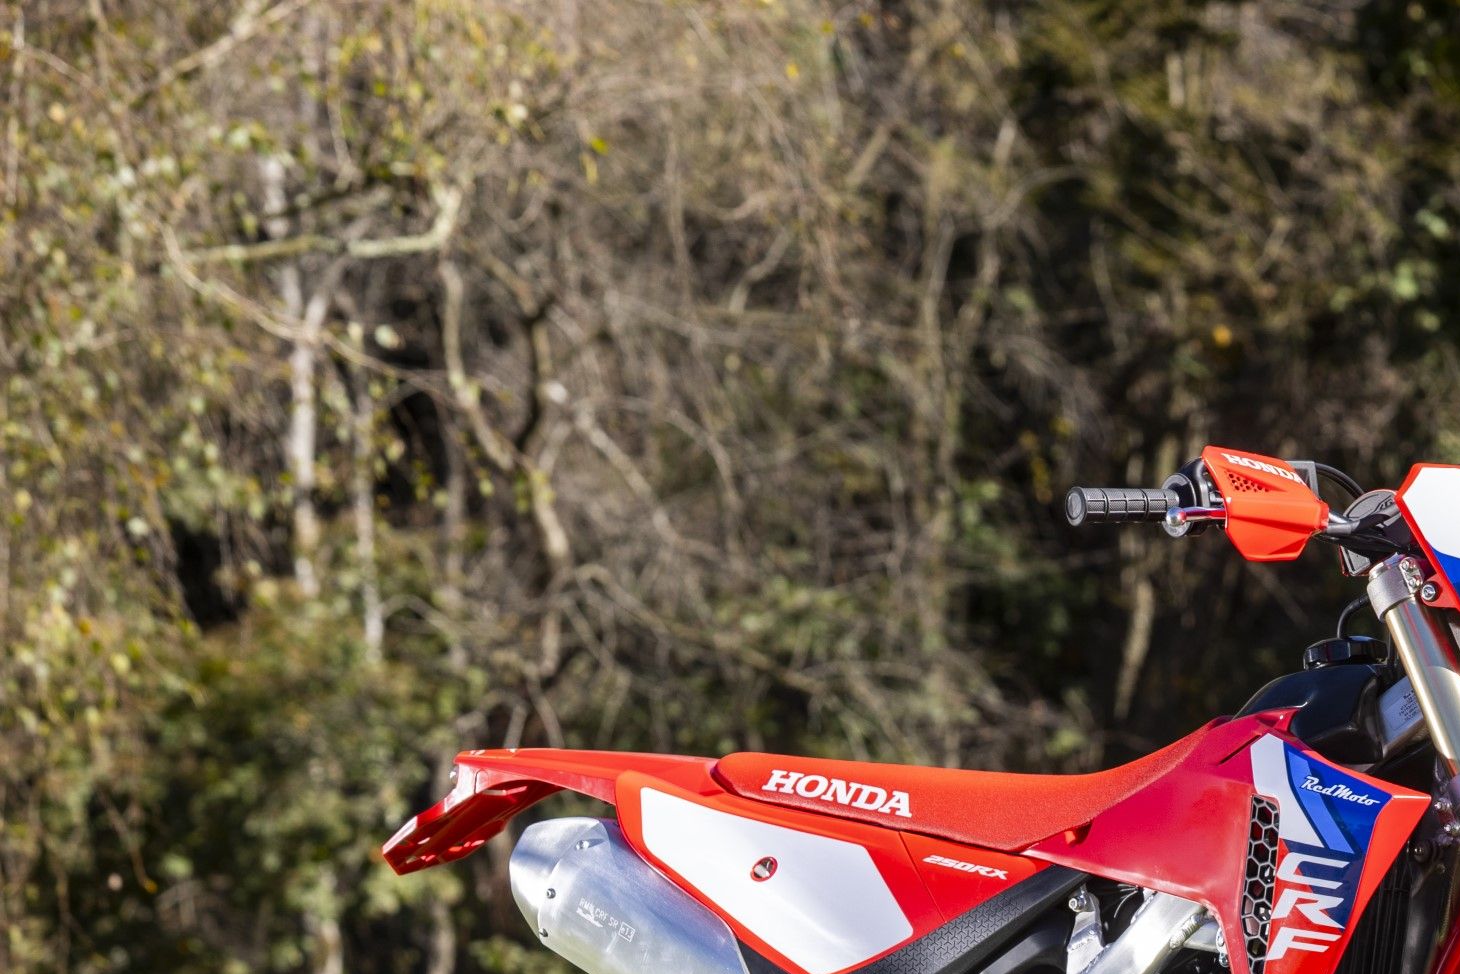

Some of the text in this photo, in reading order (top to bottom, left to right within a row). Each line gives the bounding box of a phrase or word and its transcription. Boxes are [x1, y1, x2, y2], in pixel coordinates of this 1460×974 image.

[762, 769, 912, 818] HONDA
[1301, 775, 1381, 806] RedMoto
[922, 855, 1008, 880] 250RX
[1266, 852, 1350, 961] CRF
